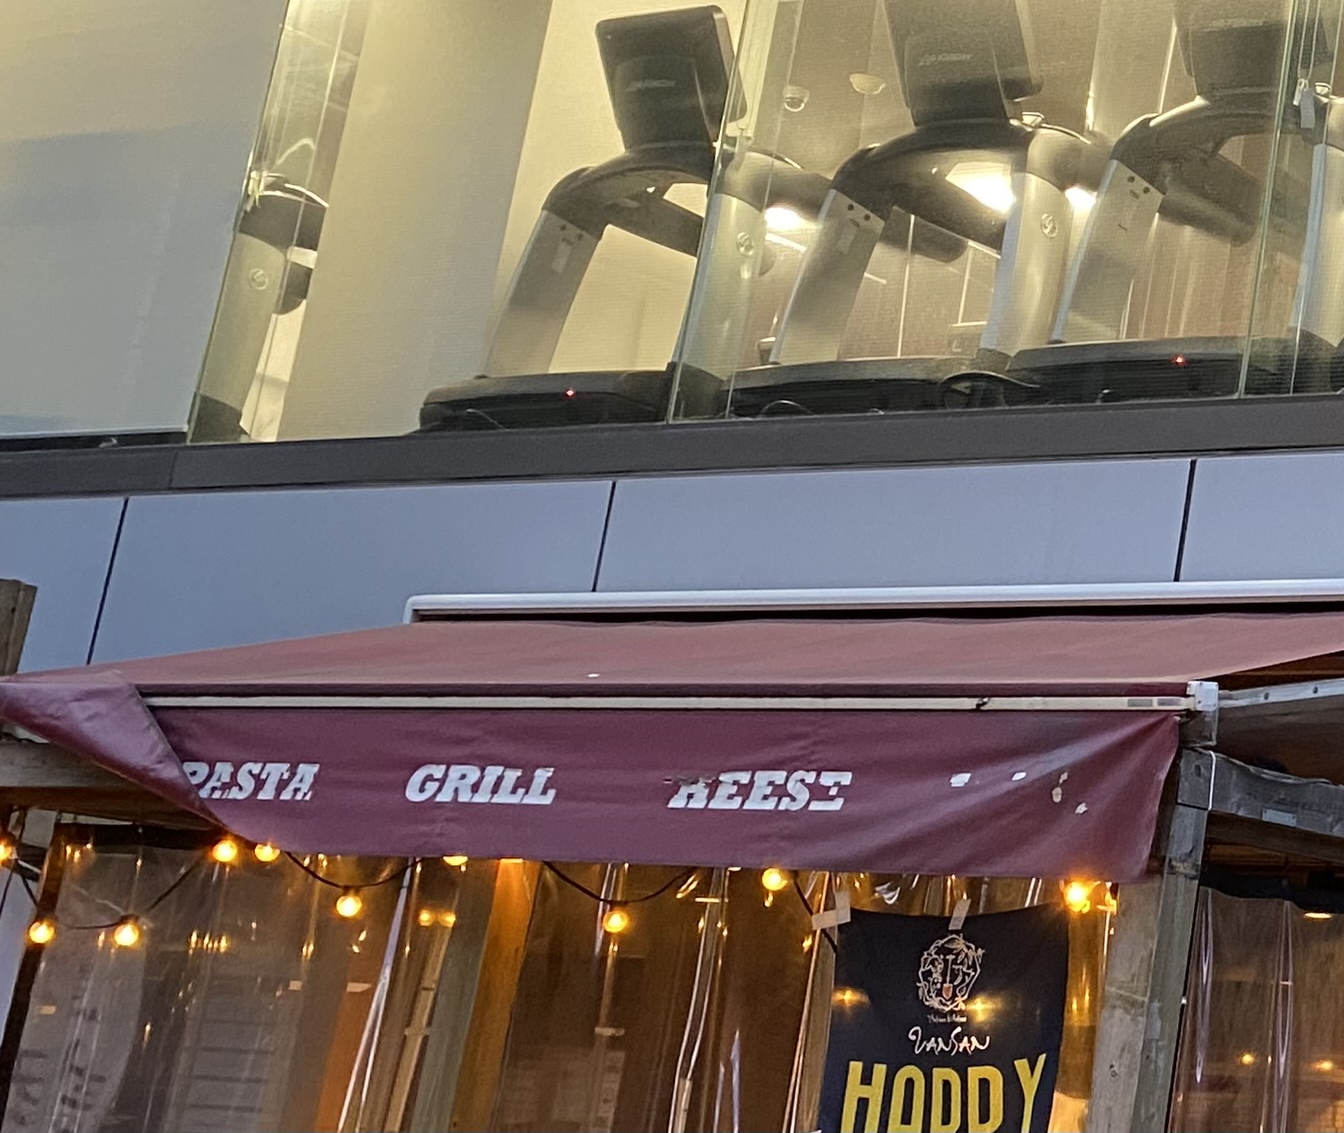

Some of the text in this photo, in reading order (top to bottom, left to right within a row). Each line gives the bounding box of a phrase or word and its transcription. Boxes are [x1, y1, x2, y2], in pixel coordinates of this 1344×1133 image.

[182, 761, 320, 801] PASTA
[405, 764, 556, 804] GRILL
[840, 1053, 1047, 1133] HAPPY
